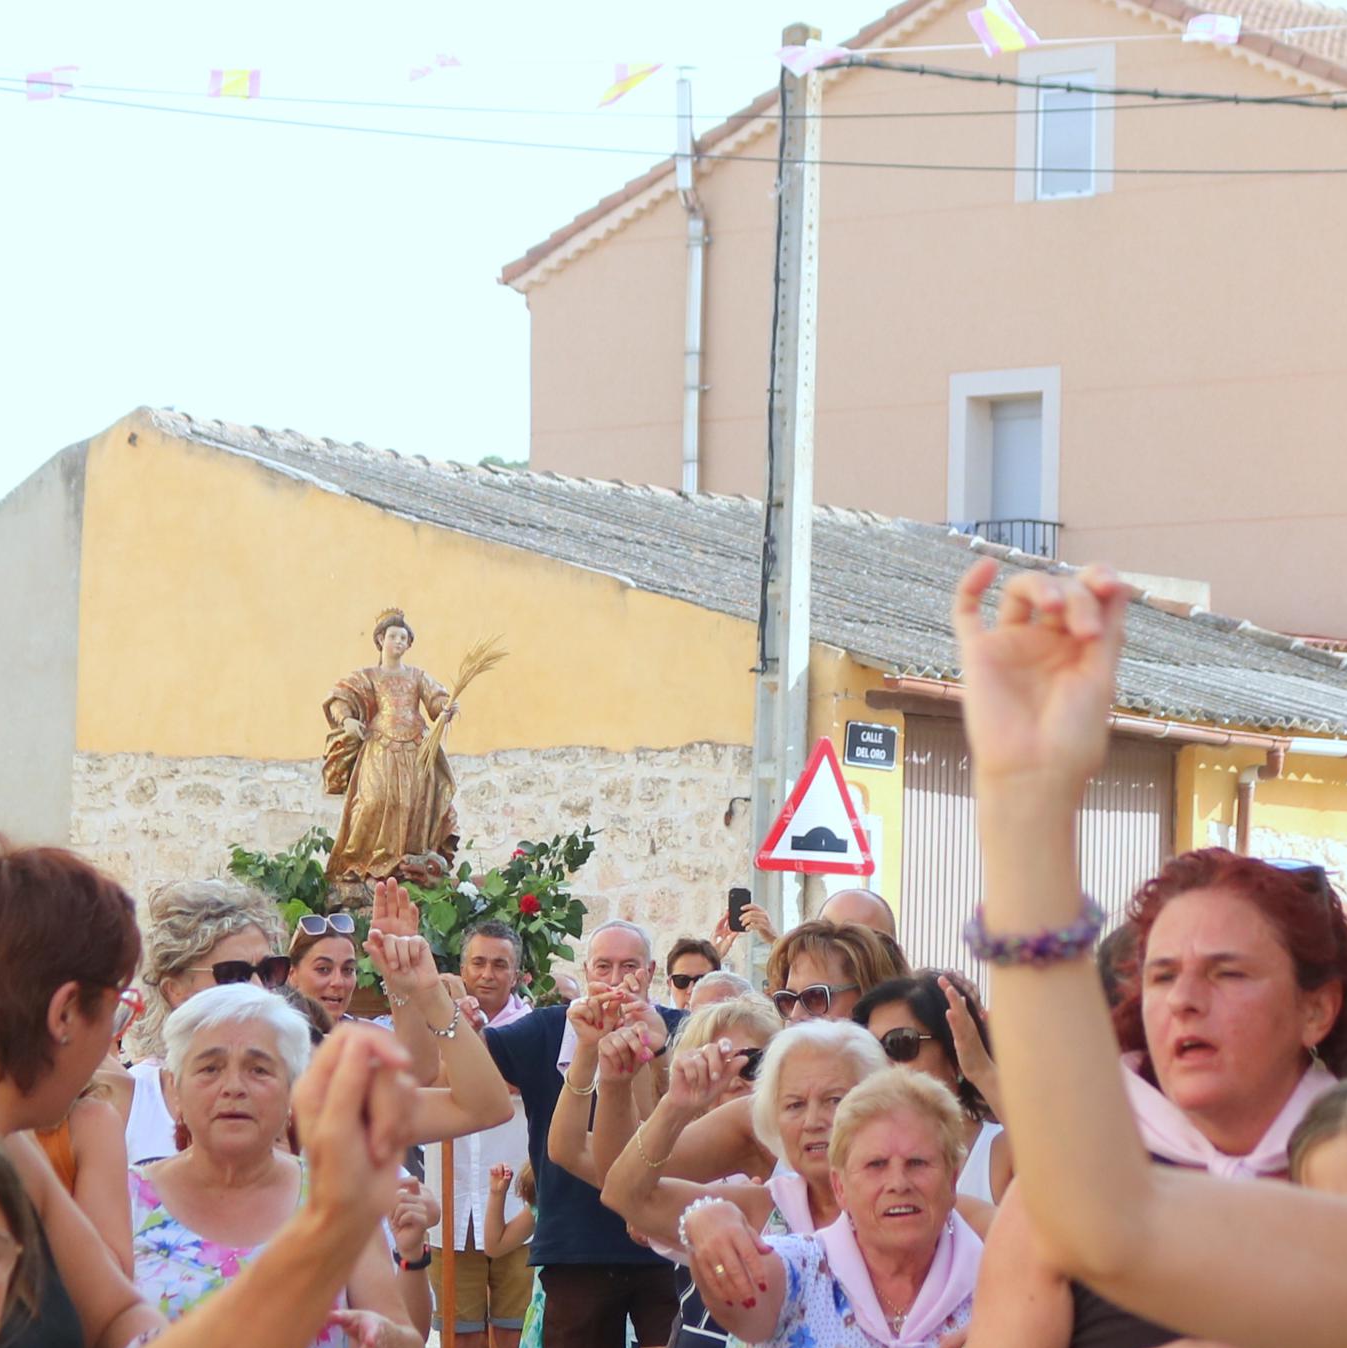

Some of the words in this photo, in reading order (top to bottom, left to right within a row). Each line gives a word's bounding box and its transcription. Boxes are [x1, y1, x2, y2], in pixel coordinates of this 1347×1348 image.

[860, 731, 883, 744] CALLE
[855, 746, 869, 758] DEL
[869, 748, 886, 760] ORO
